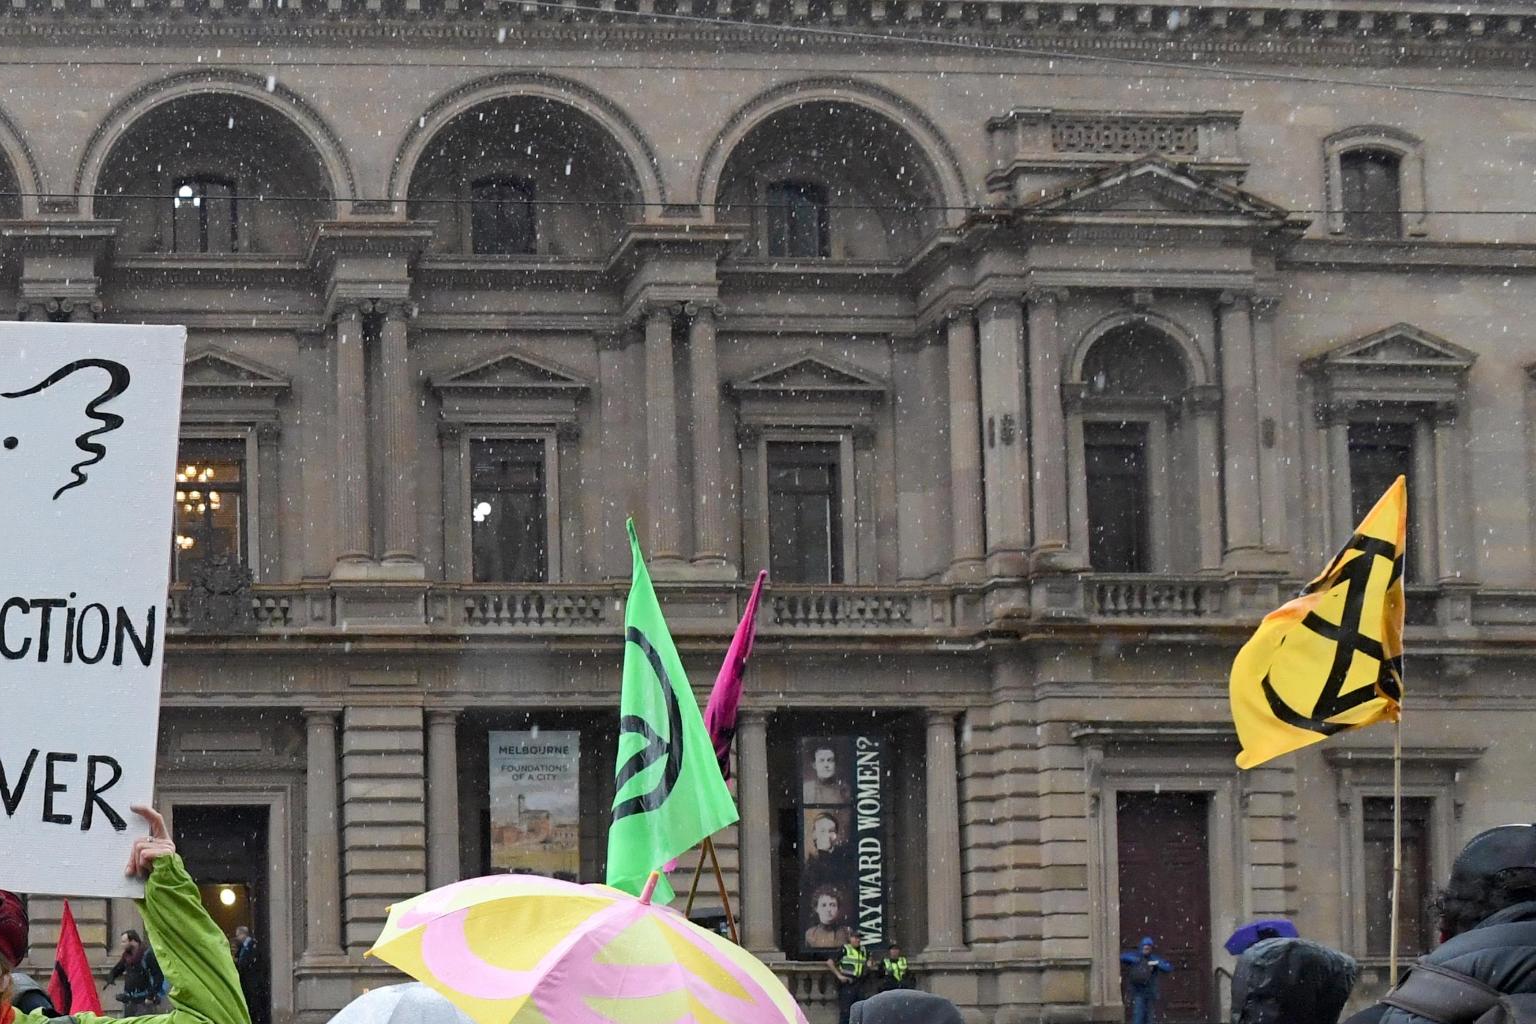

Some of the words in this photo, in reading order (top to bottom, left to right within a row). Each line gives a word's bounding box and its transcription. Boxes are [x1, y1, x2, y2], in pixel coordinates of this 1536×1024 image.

[498, 745, 570, 755] MELBOURNE
[500, 764, 568, 773] FOUNDATIONS
[511, 773, 524, 781] OF
[527, 773, 534, 781] A
[536, 773, 558, 781] CITY
[856, 736, 881, 831] WOMEN?
[858, 837, 882, 947] WAYWARD
